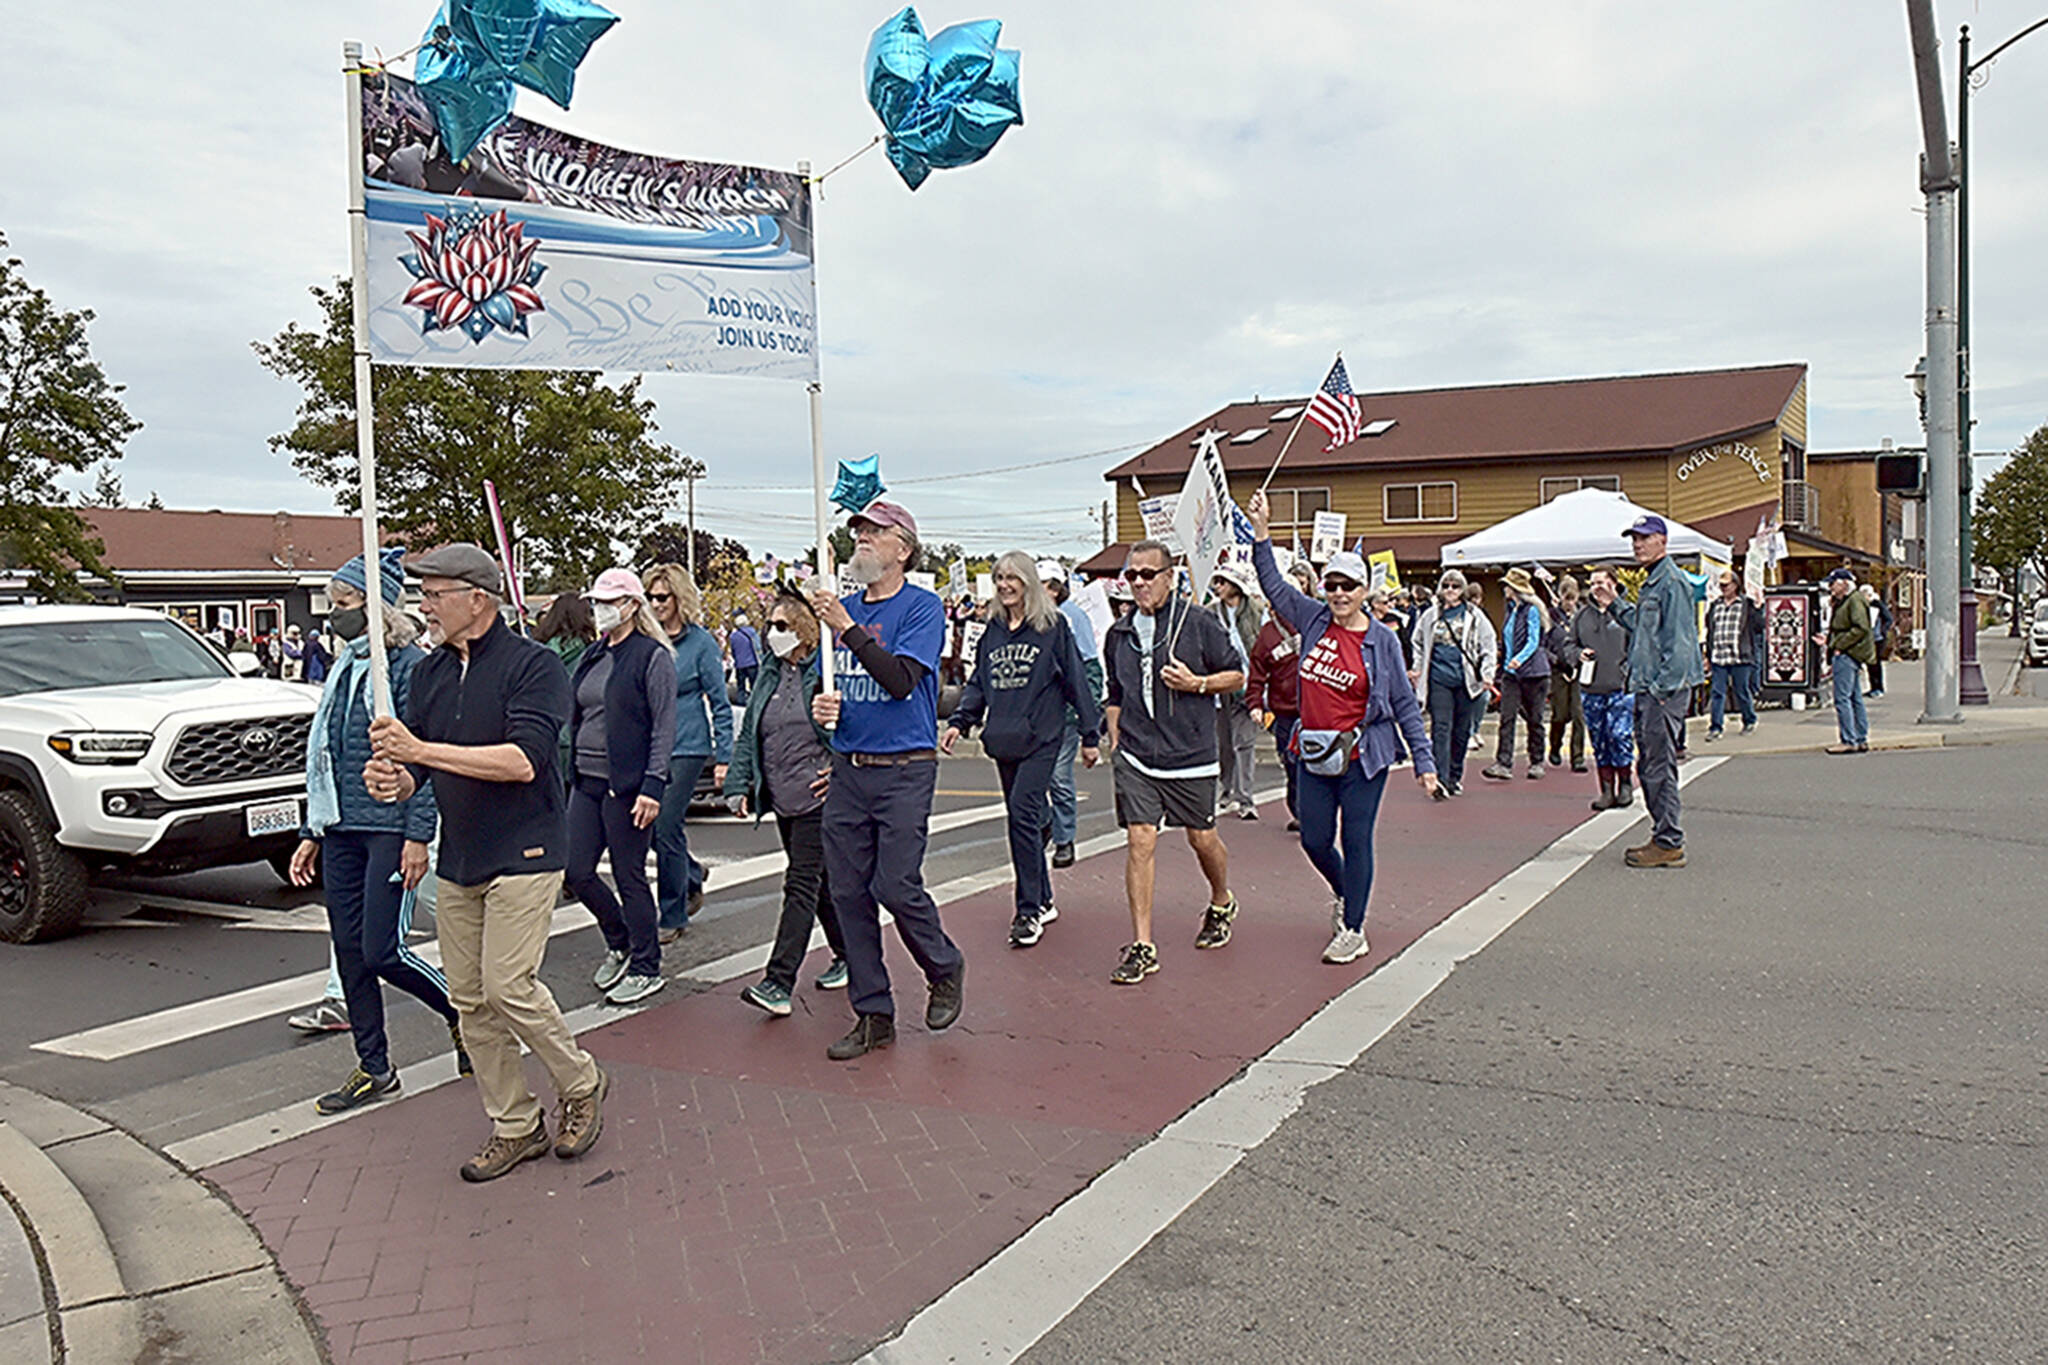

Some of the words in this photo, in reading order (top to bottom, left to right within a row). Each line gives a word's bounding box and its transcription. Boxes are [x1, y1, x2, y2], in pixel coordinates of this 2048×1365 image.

[527, 147, 681, 208] WOMEN'S
[685, 186, 790, 212] MARCH
[708, 297, 741, 317] ADD
[744, 301, 784, 324] YOUR
[717, 327, 754, 347] JOIN
[757, 330, 777, 350] US
[1677, 448, 1719, 481] OVER
[1734, 441, 1772, 483] FENCE
[1313, 662, 1358, 687] BALLOT
